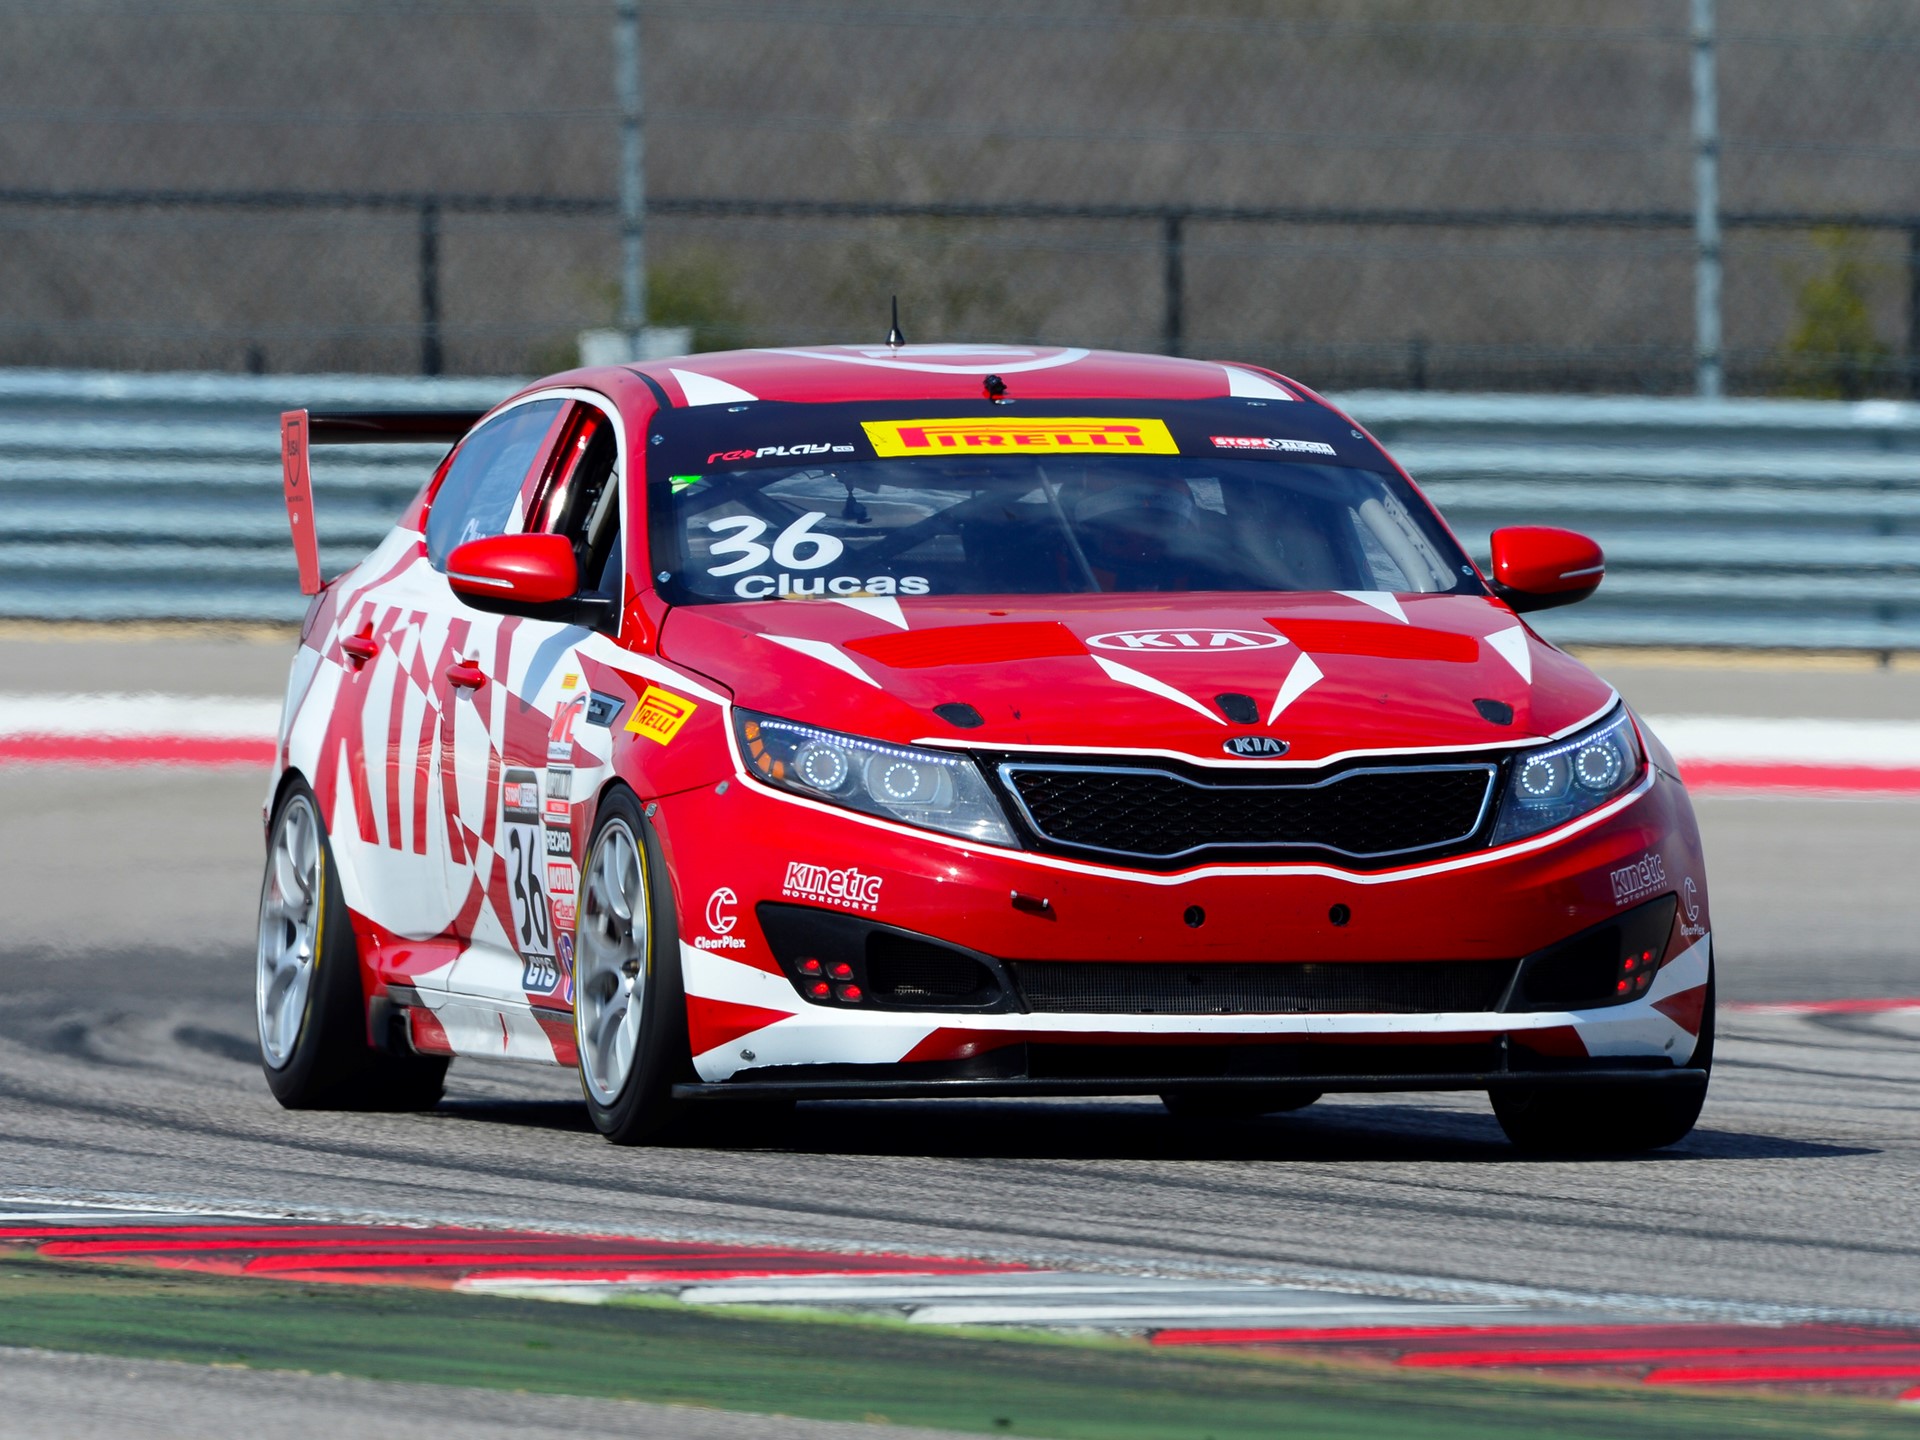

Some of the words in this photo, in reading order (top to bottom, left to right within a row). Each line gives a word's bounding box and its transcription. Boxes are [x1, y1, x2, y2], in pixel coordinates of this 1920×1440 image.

[896, 424, 1145, 448] PIRELLI
[706, 511, 844, 577] 36
[733, 573, 931, 599] Clucas
[1115, 632, 1261, 649] KIA
[631, 694, 686, 735] PIRELLI
[1232, 737, 1281, 754] KIA
[509, 827, 549, 951] 36
[782, 888, 878, 913] MOTORSPORTS
[694, 936, 747, 950] ClearPlex
